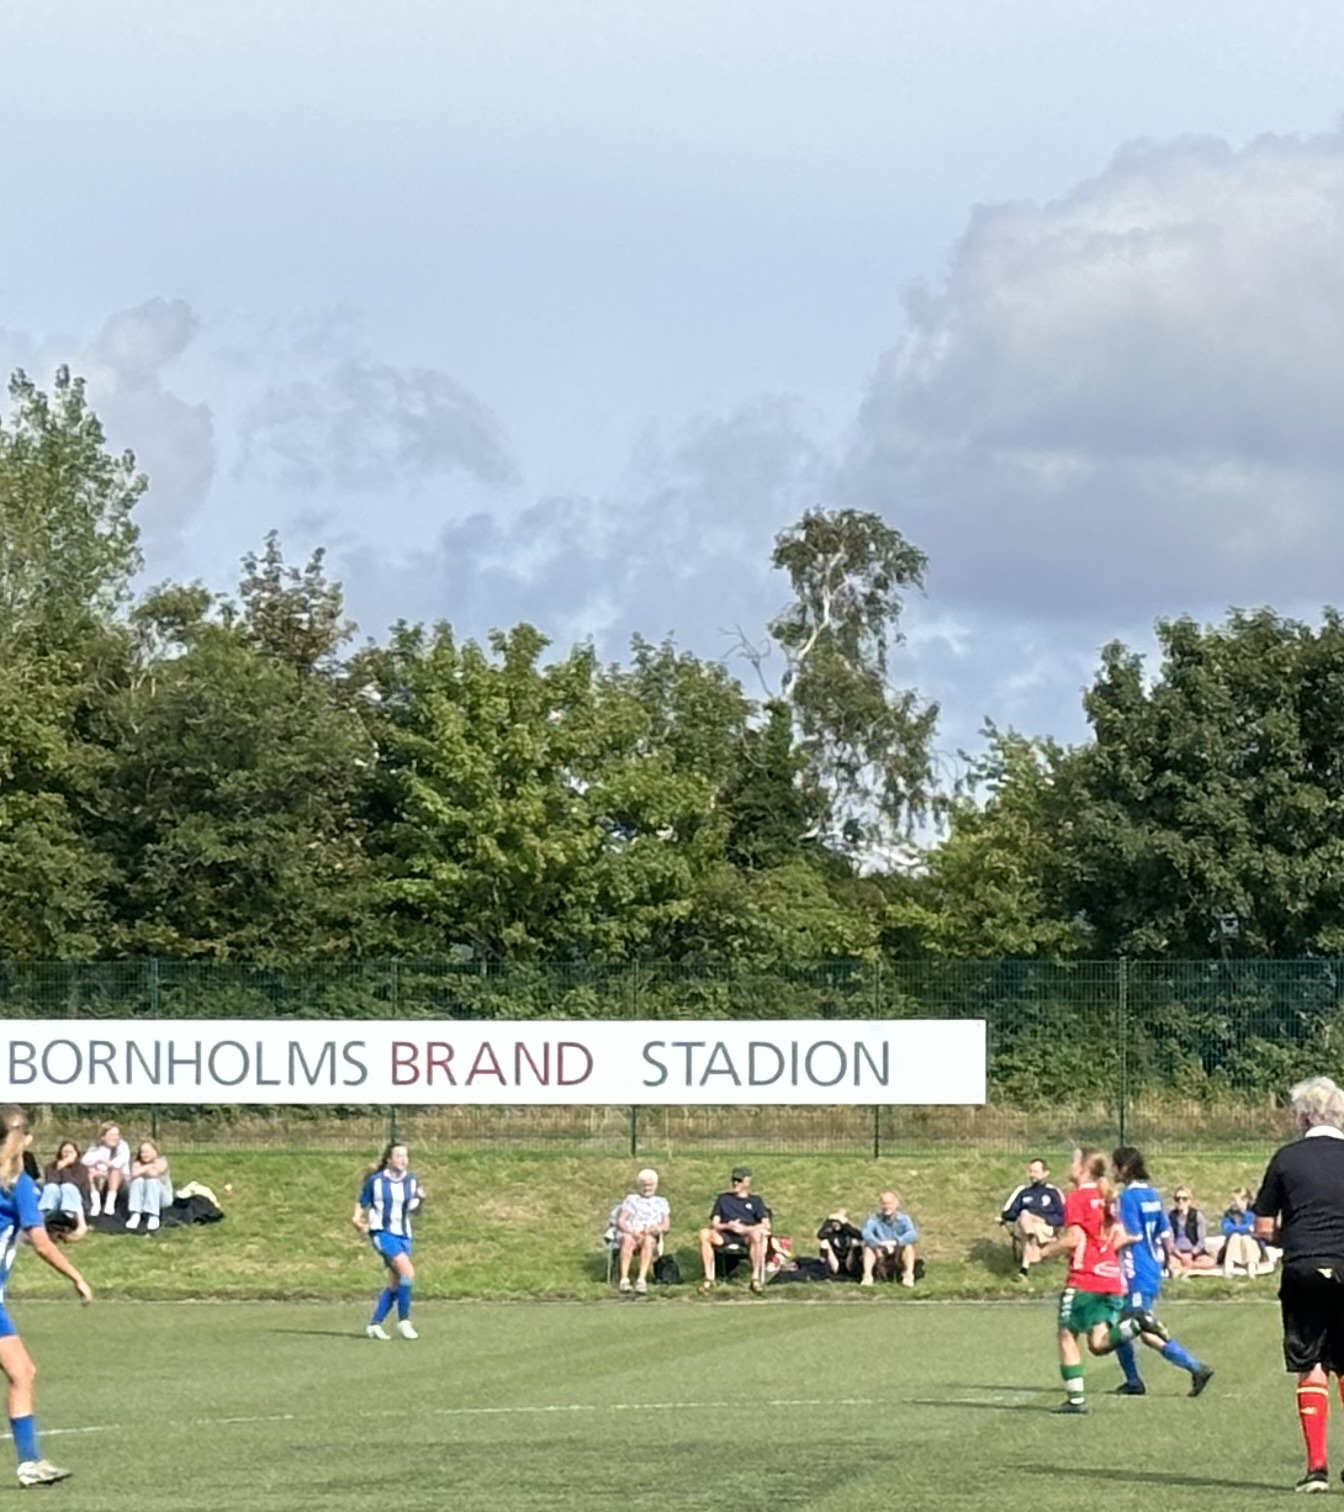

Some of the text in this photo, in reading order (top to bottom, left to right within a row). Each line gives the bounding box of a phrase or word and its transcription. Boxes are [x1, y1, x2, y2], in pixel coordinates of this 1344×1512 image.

[9, 1040, 889, 1087] BORNHOLMS BRAND STADION
